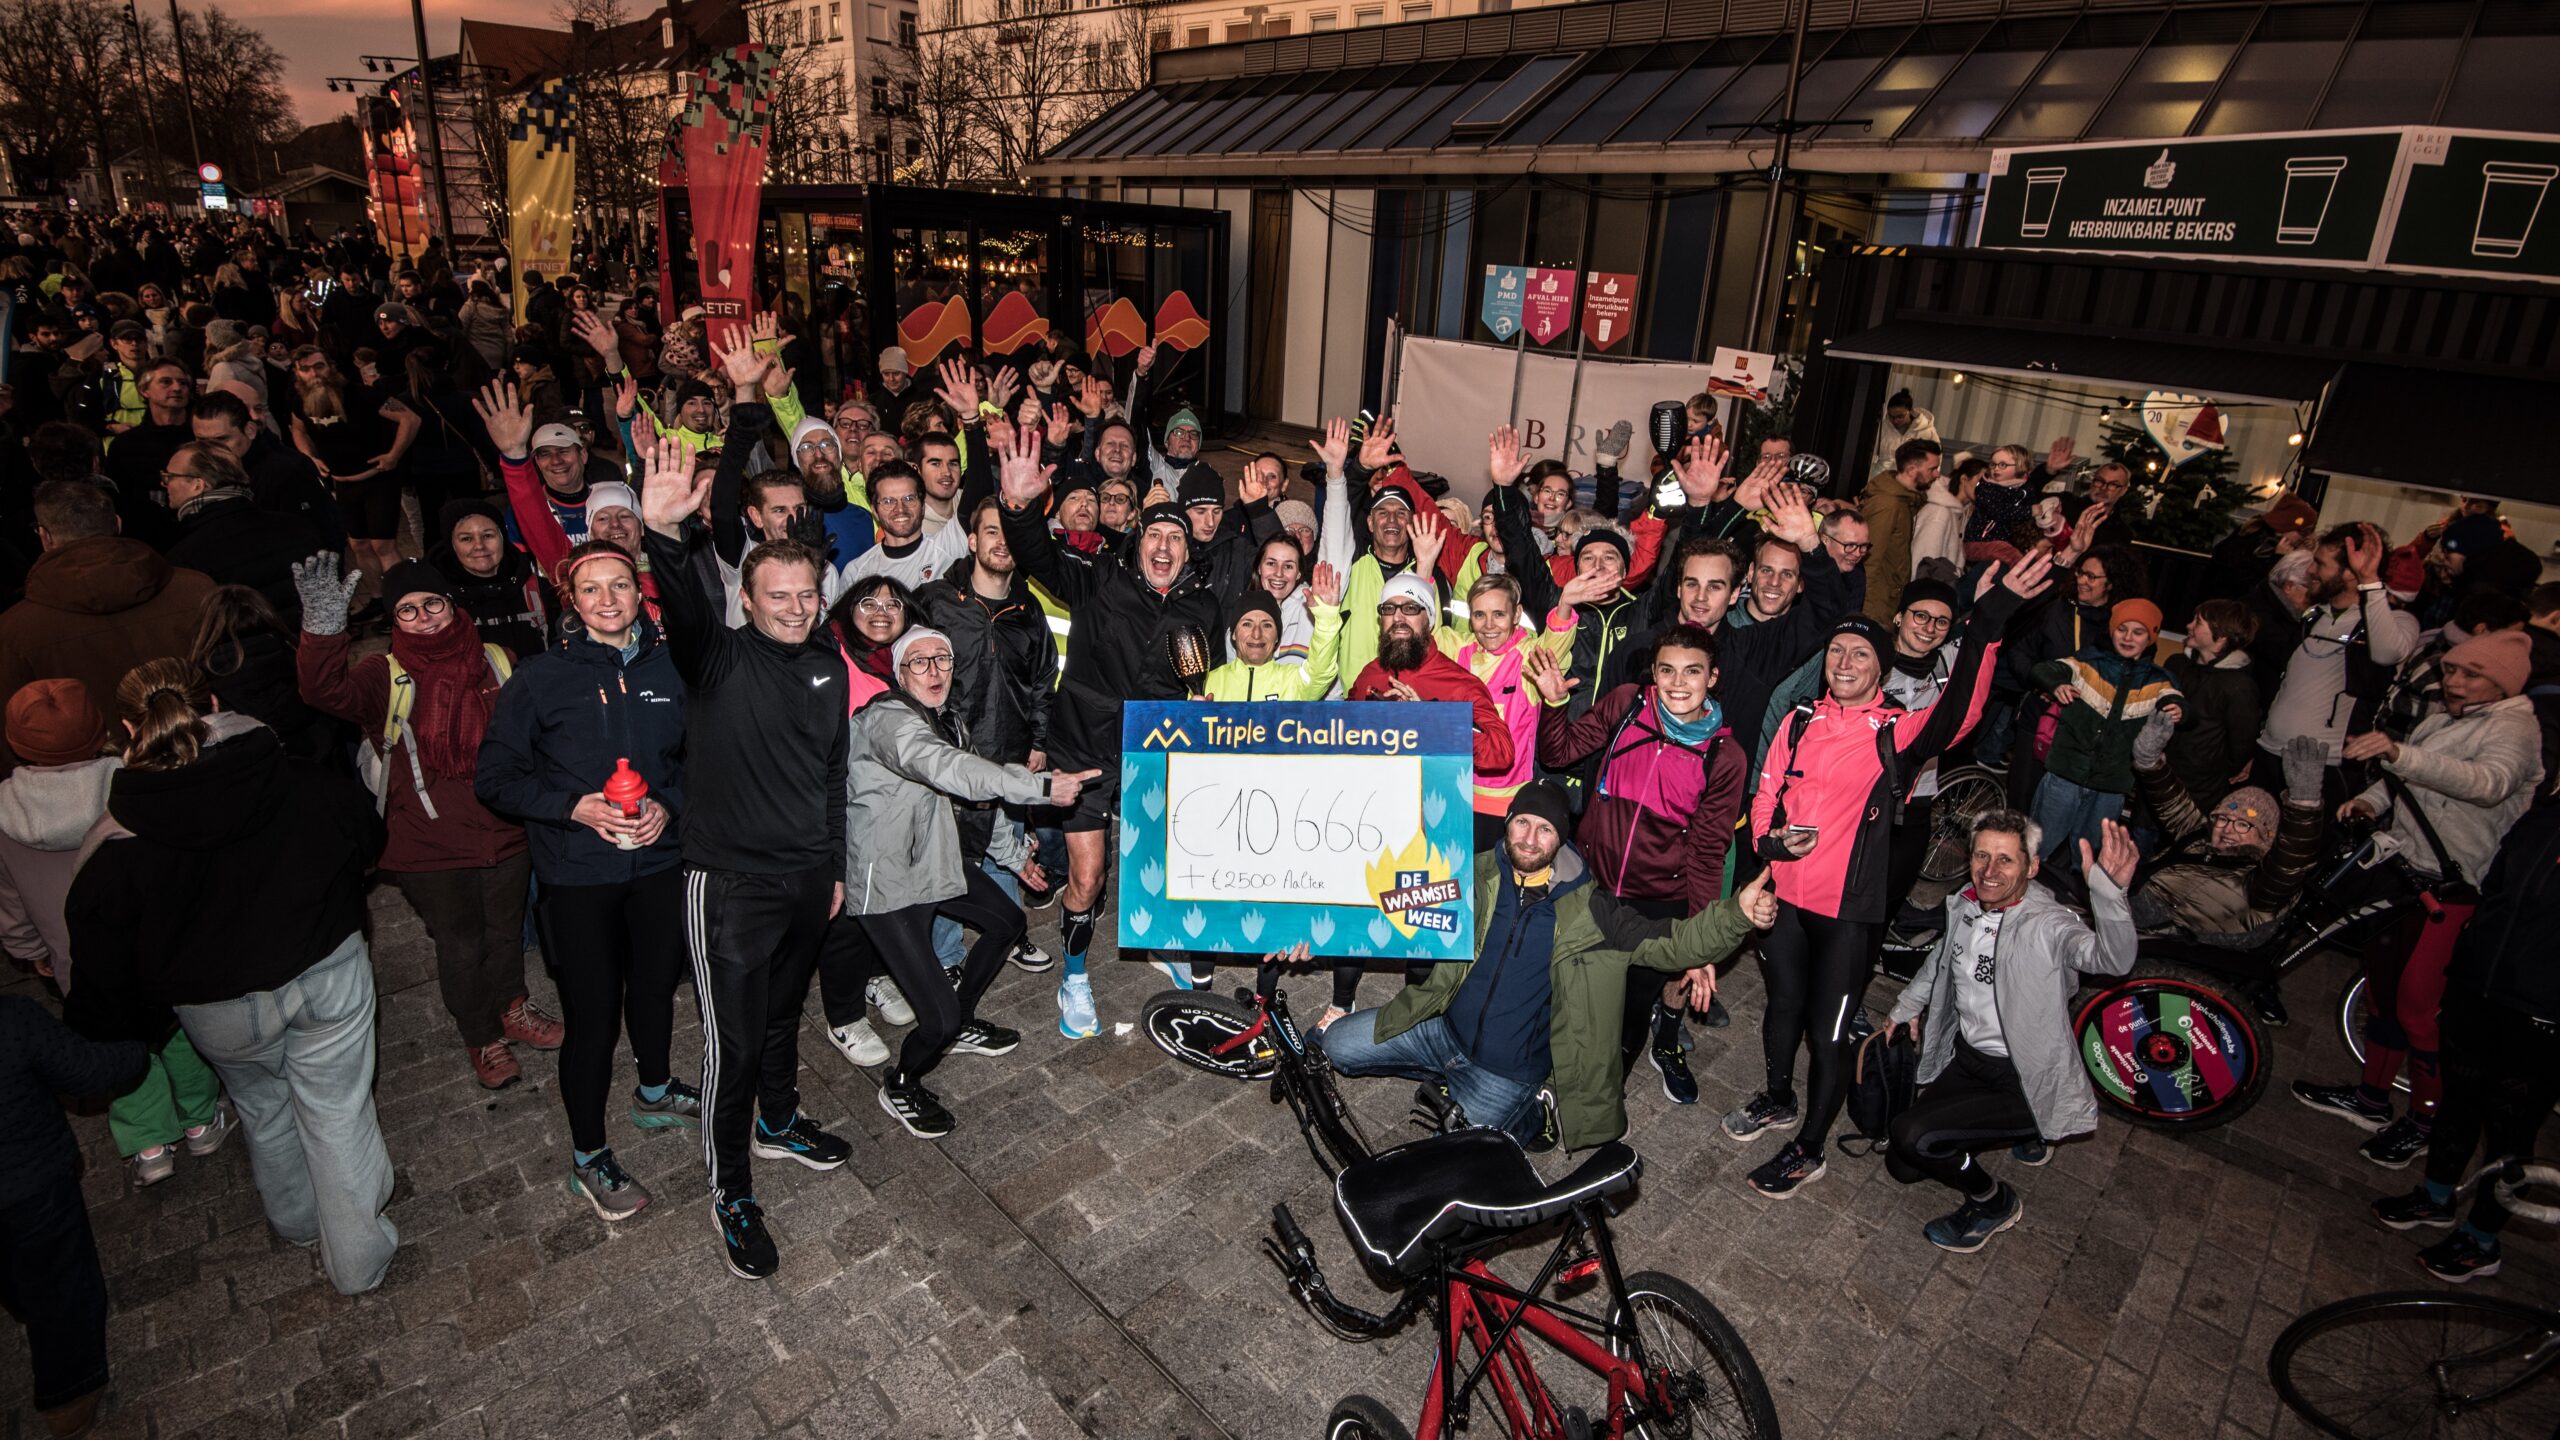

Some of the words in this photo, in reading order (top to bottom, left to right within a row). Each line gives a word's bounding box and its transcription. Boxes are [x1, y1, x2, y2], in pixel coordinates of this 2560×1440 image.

[2103, 198, 2206, 217] INZAMELPUNT
[2068, 220, 2173, 240] HERBRUIKBARE
[2174, 221, 2236, 241] BEKERS
[1497, 291, 1517, 300] PMD
[1527, 293, 1550, 301] AFVAL
[1551, 294, 1569, 303] HIER
[1589, 294, 1629, 304] Inzamelpunt
[1587, 302, 1629, 312] herbruikbare
[1596, 309, 1617, 318] bekers
[1202, 717, 1266, 748] Triple
[1277, 718, 1419, 755] Challenge
[1211, 869, 1276, 890] €2500
[1401, 873, 1422, 888] DE
[1384, 883, 1457, 911] WARMSTE
[1408, 909, 1453, 931] WEEK
[1282, 1017, 1302, 1050] TRIGO
[2118, 1024, 2129, 1033] de
[2128, 1017, 2148, 1031] punt.
[2186, 1030, 2204, 1050] loterij
[2193, 1026, 2217, 1055] nationale
[2092, 1042, 2138, 1095] #SPORTFORGOOD
[2110, 1045, 2135, 1073] nationale
[2123, 1052, 2142, 1071] loterij
